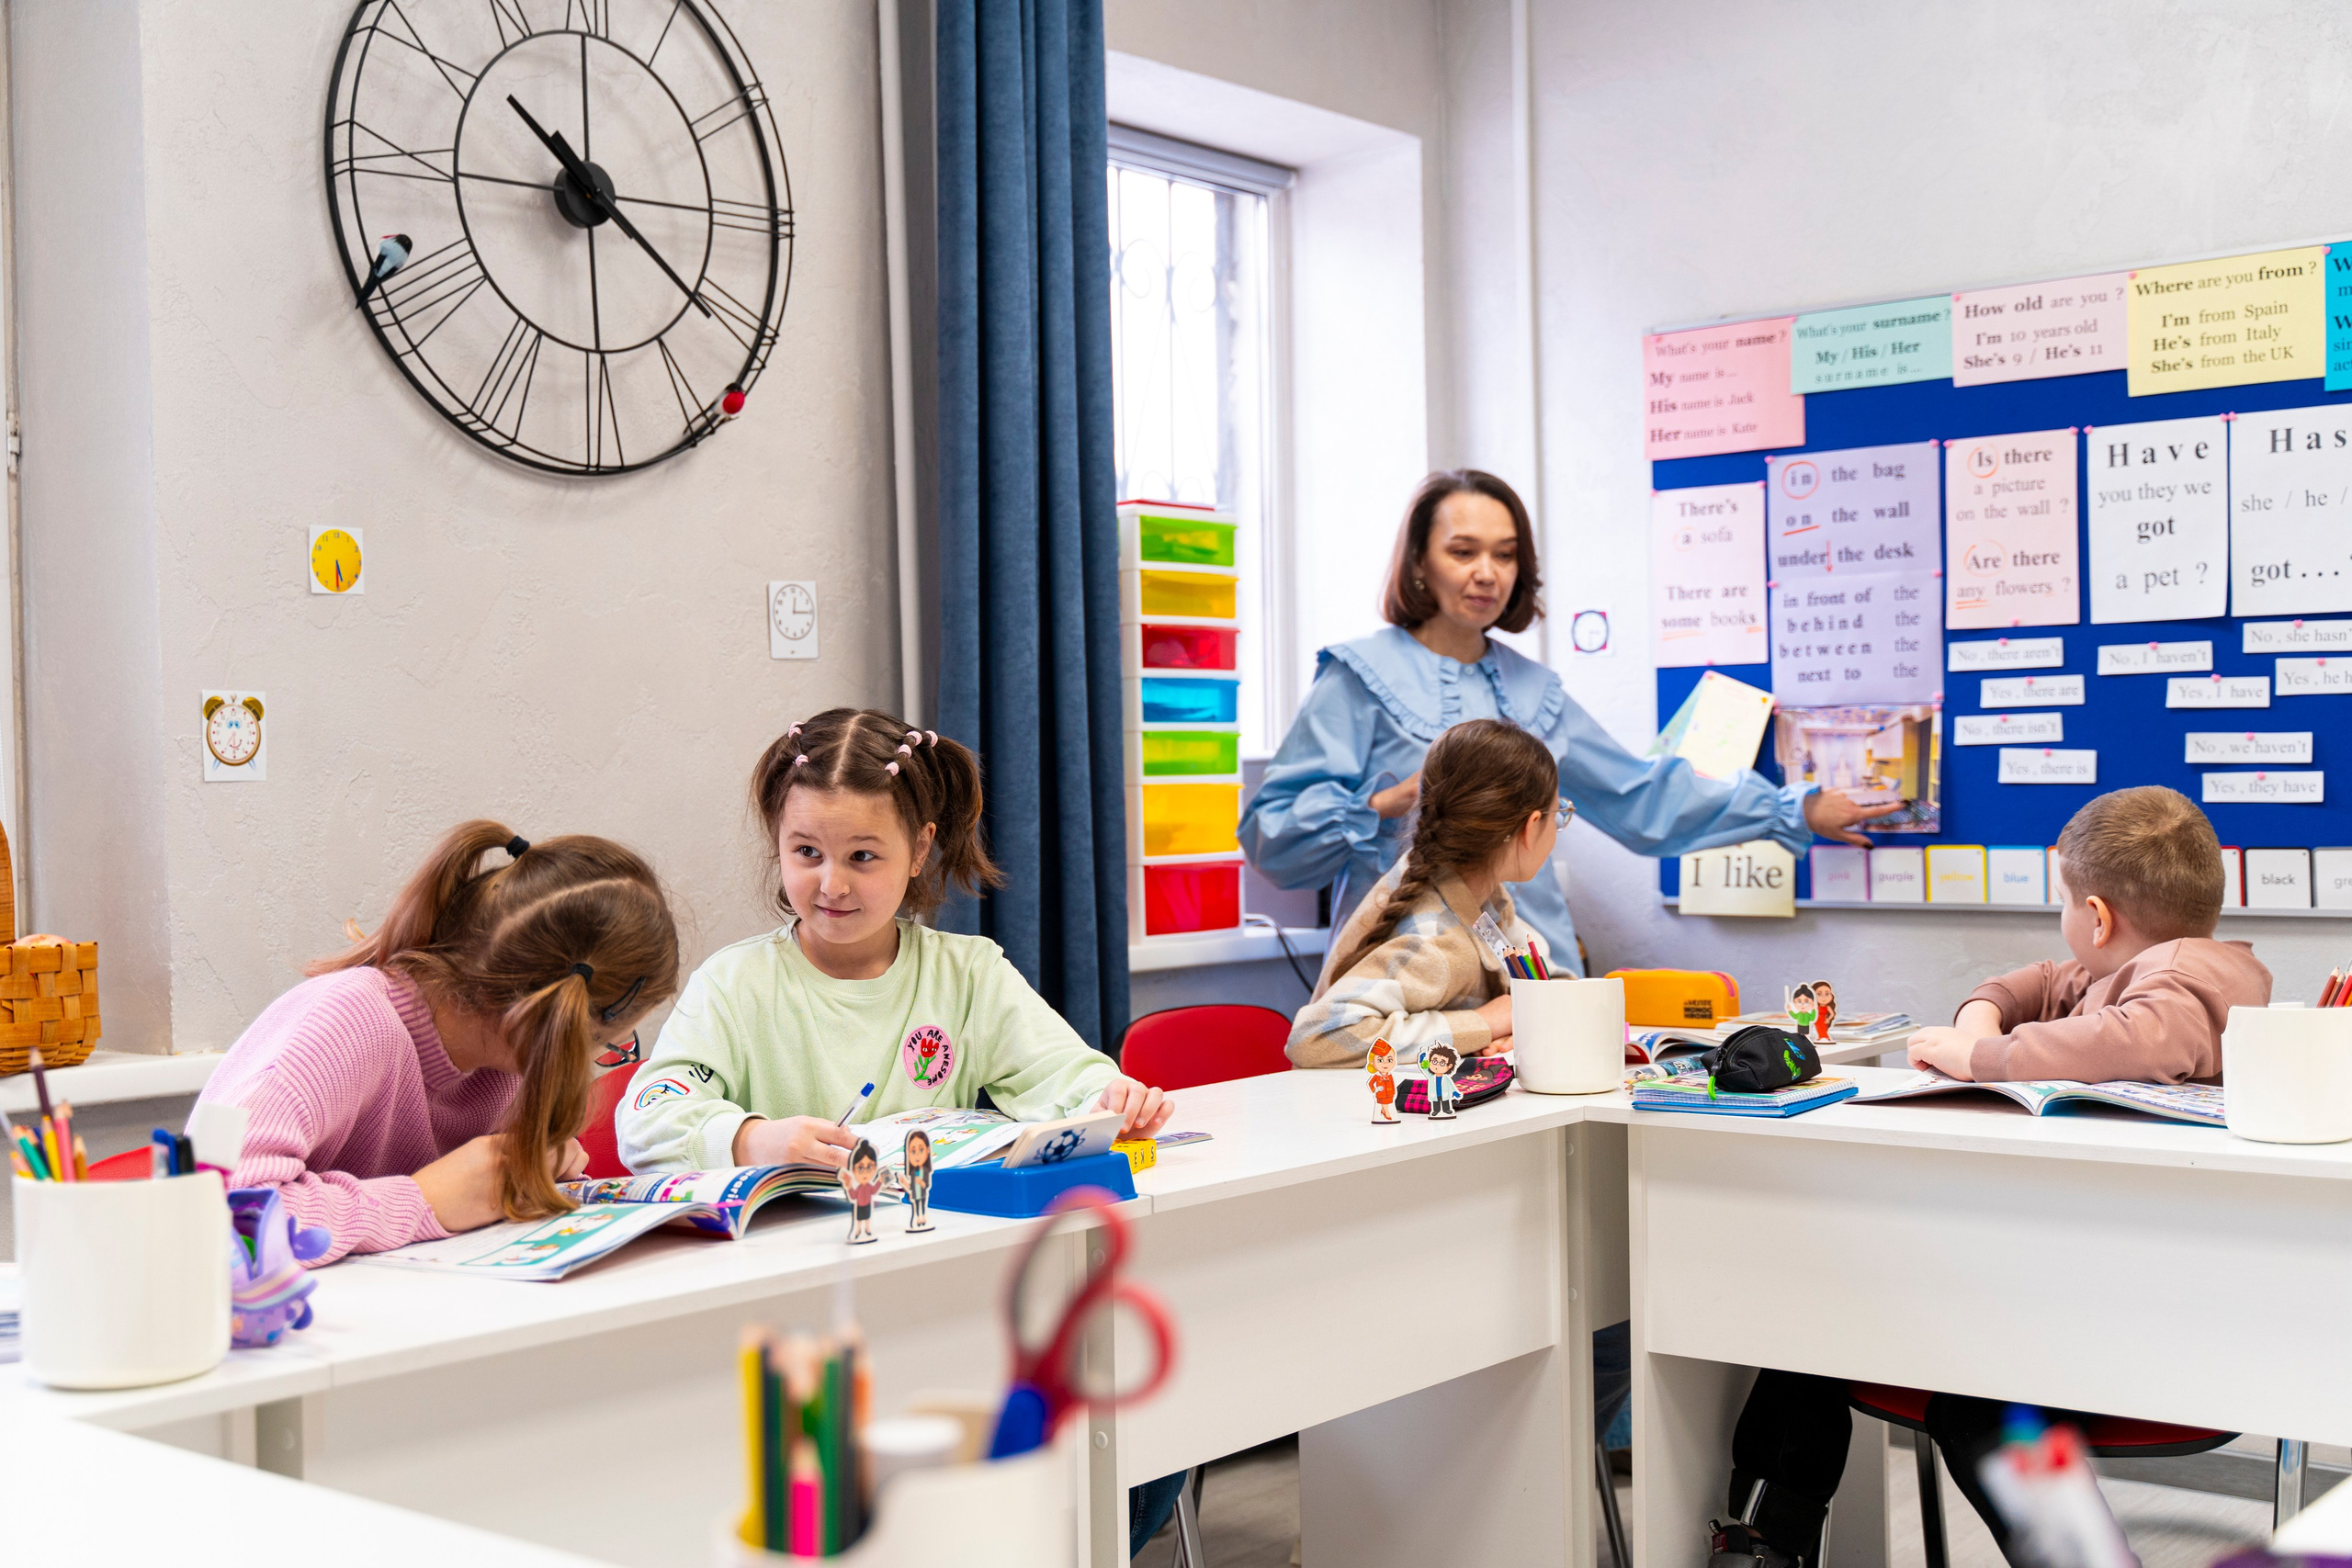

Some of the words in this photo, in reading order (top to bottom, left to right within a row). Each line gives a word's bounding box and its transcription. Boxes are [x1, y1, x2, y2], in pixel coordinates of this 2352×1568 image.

[2135, 277, 2193, 298] Where
[2198, 275, 2222, 289] are
[2225, 271, 2253, 289] you
[2257, 264, 2304, 281] from
[1964, 303, 2005, 319] How
[2014, 295, 2043, 312] old
[2050, 296, 2074, 309] are
[2080, 292, 2108, 308] you
[2161, 313, 2190, 329] I'm
[2199, 307, 2236, 324] from
[2244, 301, 2289, 320] Spain
[1797, 324, 1838, 339] What's
[1838, 322, 1866, 337] your
[1872, 312, 1940, 330] surname
[1976, 331, 2002, 346] I'm
[2009, 331, 2027, 343] 10
[2032, 322, 2070, 343] years
[2075, 318, 2098, 334] old
[1656, 343, 1697, 358] What's
[1702, 339, 1729, 355] your
[1736, 333, 1775, 347] name
[2153, 335, 2191, 354] He's
[2199, 331, 2237, 347] from
[2245, 324, 2282, 343] Italy
[1815, 350, 1838, 366] My
[1851, 344, 1877, 359] His
[1891, 341, 1921, 355] Her
[1963, 352, 2006, 369] She's
[2012, 353, 2022, 367] 9
[2045, 344, 2081, 360] He's
[2090, 344, 2103, 355] 11
[2151, 357, 2193, 374] She's
[2200, 353, 2235, 369] from
[2243, 349, 2266, 365] the
[2270, 345, 2294, 362] UK
[1649, 372, 1674, 388] My
[1679, 371, 1709, 383] name
[1649, 400, 1678, 414] His
[1680, 400, 1711, 412] name
[1713, 397, 1723, 408] is
[1726, 392, 1754, 406] Jack
[1649, 428, 1681, 444] Her
[1683, 427, 1714, 439] name
[1717, 424, 1725, 436] is
[1731, 422, 1758, 435] Kate
[2269, 427, 2346, 454] Has
[1976, 450, 1994, 468] Is
[2005, 447, 2053, 465] there
[2108, 438, 2210, 468] Have
[1791, 471, 1812, 486] in
[1831, 466, 1858, 482] the
[1872, 462, 1905, 479] bag
[1973, 483, 1983, 496] a
[1992, 477, 2046, 497] picture
[2098, 488, 2132, 508] you
[2138, 483, 2177, 503] they
[2183, 480, 2211, 496] we
[1679, 499, 1738, 517] There's
[1956, 508, 1974, 522] on
[1984, 503, 2007, 520] the
[2017, 499, 2050, 516] wall
[2241, 493, 2273, 513] she
[2305, 489, 2328, 508] he
[1786, 513, 1812, 527] on
[1832, 507, 1859, 523] the
[1874, 502, 1910, 519] wall
[1682, 532, 1691, 545] a
[1701, 528, 1733, 543] sofa
[2136, 515, 2176, 542] got
[1778, 550, 1826, 567] under
[1837, 547, 1864, 562] the
[1874, 543, 1915, 559] desk
[1967, 554, 2002, 570] Are
[2012, 550, 2061, 567] there
[1956, 584, 1985, 600] any
[1996, 580, 2052, 596] flowers
[2115, 574, 2128, 589] a
[2143, 568, 2179, 593] pet
[1667, 585, 1712, 601] There
[1722, 585, 1747, 598] are
[1783, 594, 1798, 608] in
[1806, 592, 1846, 605] front
[1854, 589, 1871, 604] of
[1894, 586, 1920, 601] the
[1661, 615, 1702, 629] some
[1711, 610, 1757, 626] books
[1787, 615, 1863, 633] behind
[1895, 611, 1920, 626] the
[2286, 629, 2310, 643] she
[1780, 641, 1871, 658] between
[1894, 637, 1920, 652] the
[1798, 668, 1831, 682] next
[1844, 667, 1861, 680] to
[1893, 663, 1919, 678] the
[2324, 671, 2339, 685] he
[2216, 685, 2222, 698] I
[2229, 684, 2263, 698] have
[2229, 743, 2251, 754] we
[2254, 739, 2307, 754] haven't
[2248, 779, 2278, 795] they
[2283, 779, 2316, 793] have
[1690, 856, 1702, 887] I
[1723, 855, 1783, 888] like
[2261, 873, 2294, 885] black
[908, 1031, 922, 1052] YOU
[927, 1029, 943, 1043] ARE
[927, 1044, 950, 1086] AWESOME
